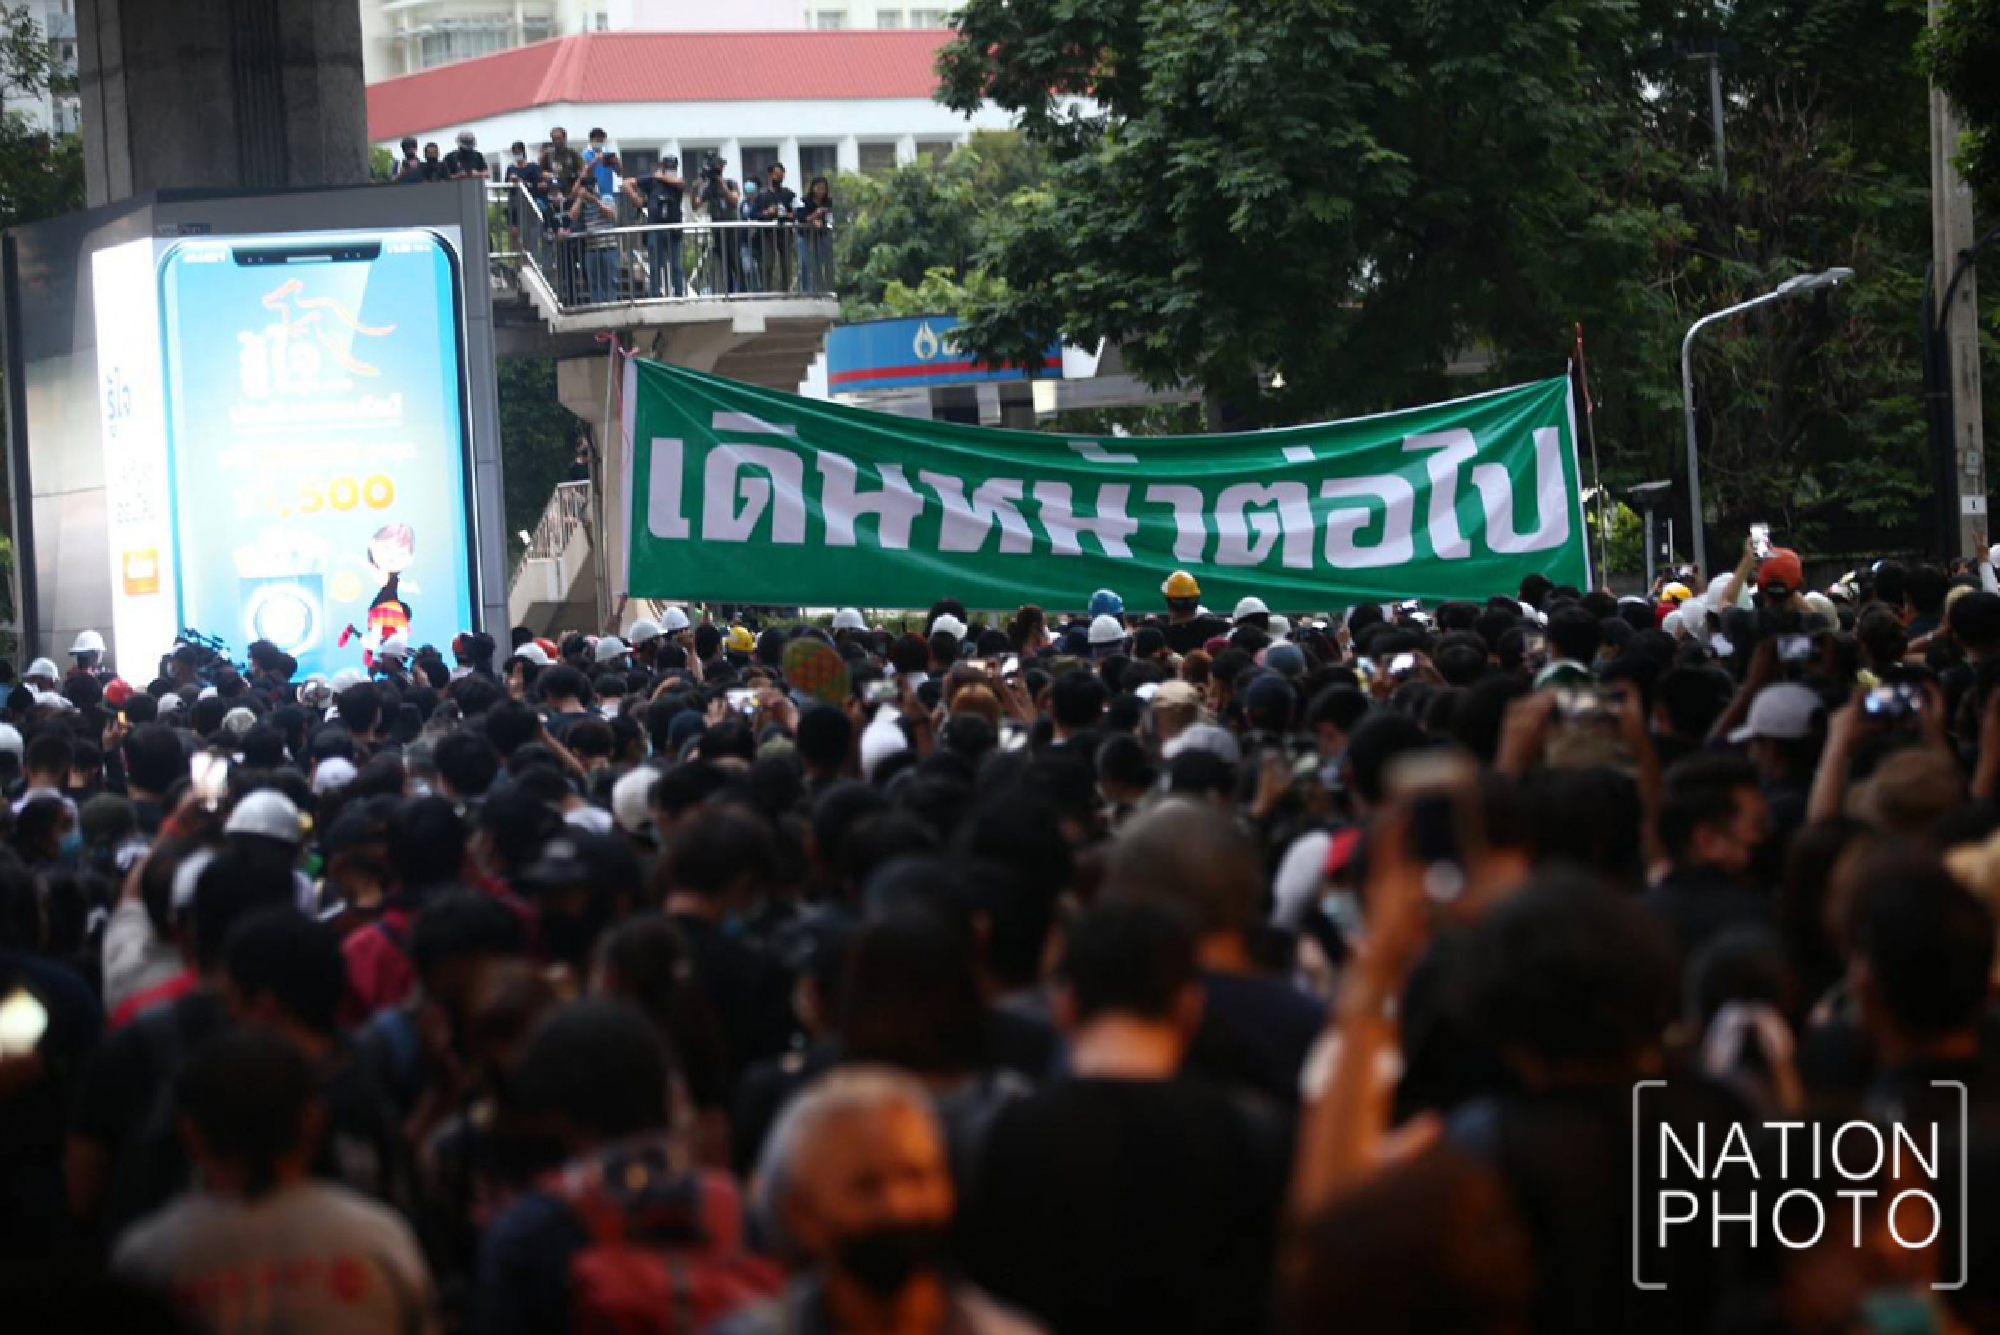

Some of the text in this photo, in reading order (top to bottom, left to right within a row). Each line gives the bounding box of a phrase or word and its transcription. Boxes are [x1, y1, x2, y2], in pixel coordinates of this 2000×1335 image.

[648, 412, 1570, 568] เดินหน้าต่อไป
